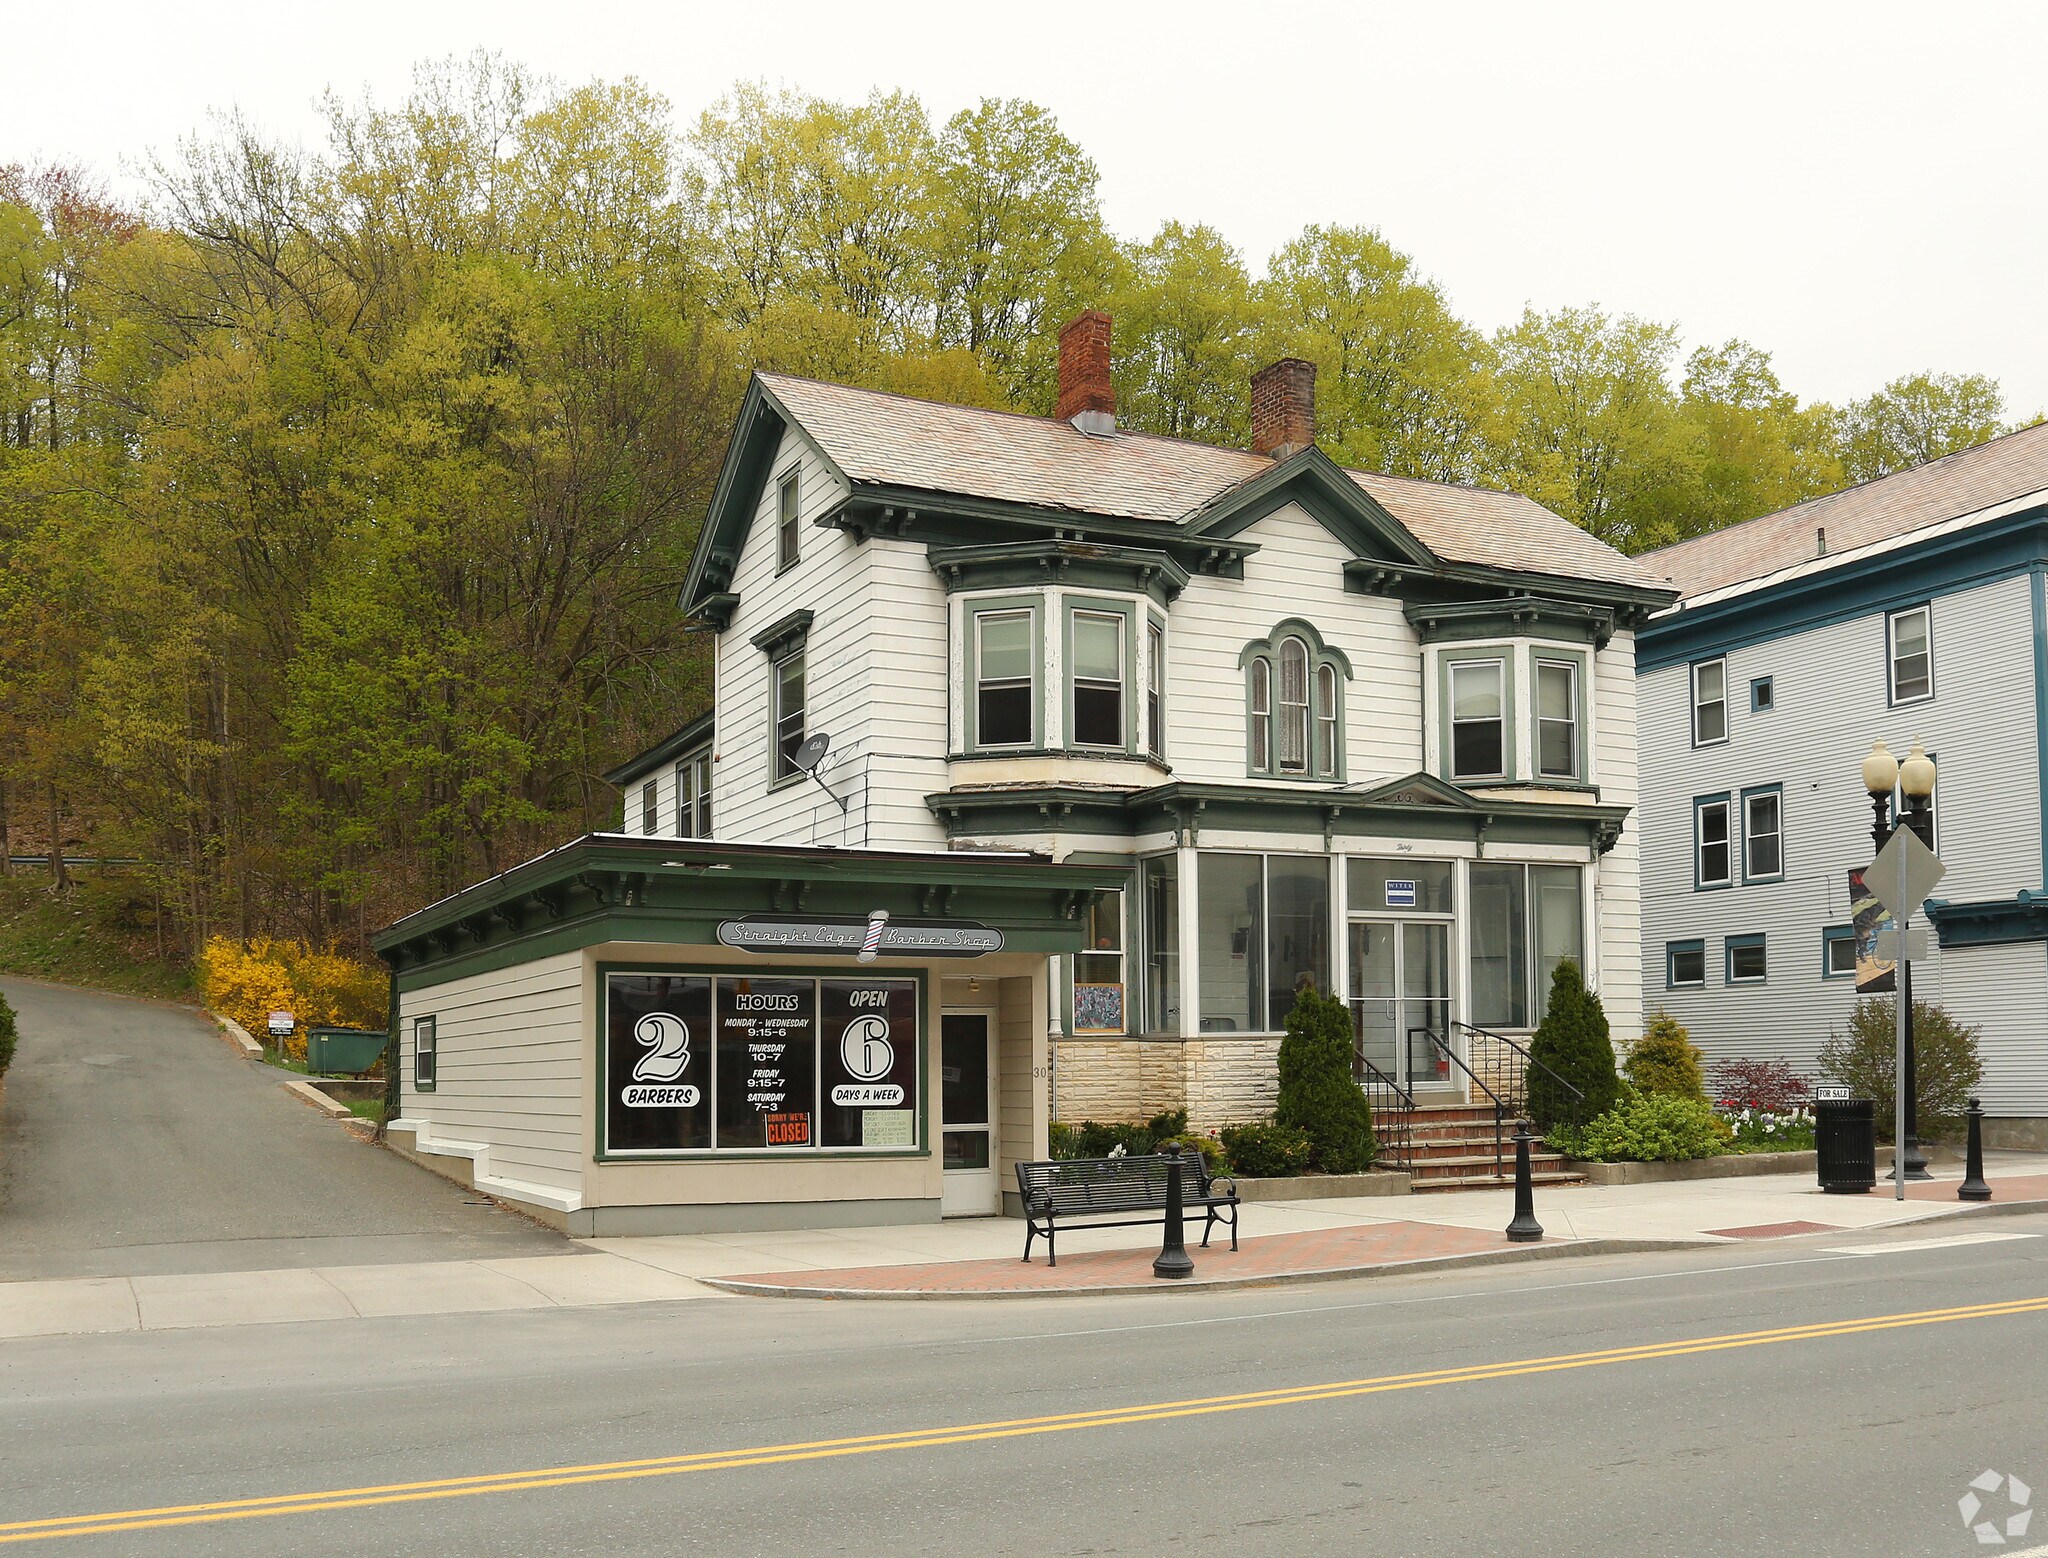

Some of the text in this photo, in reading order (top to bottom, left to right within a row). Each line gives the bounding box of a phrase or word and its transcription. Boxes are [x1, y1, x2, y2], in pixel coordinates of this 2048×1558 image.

[731, 924, 995, 949] Straight Edge Barber Shop
[736, 994, 799, 1011] HOURS
[849, 990, 889, 1007] OPEN
[725, 1018, 757, 1027] MONDAY
[765, 1018, 809, 1028] WEDNESDAY
[747, 1028, 787, 1037] 9:15-6
[632, 1011, 691, 1082] 2
[748, 1044, 786, 1053] THURSDAY
[840, 1014, 895, 1082] 6
[751, 1053, 781, 1061] 10-7
[752, 1069, 780, 1078] FRIDAY
[1033, 1067, 1047, 1078] 30
[747, 1078, 786, 1087] 9:15-7
[628, 1088, 693, 1104] BARBERS
[746, 1093, 786, 1102] SATURDAY
[836, 1089, 900, 1100] DAYS A WEEK
[1819, 1089, 1848, 1098] FOR SALE
[754, 1103, 778, 1111] 7-3
[767, 1114, 787, 1122] SORRY
[768, 1122, 808, 1143] CLOSED
